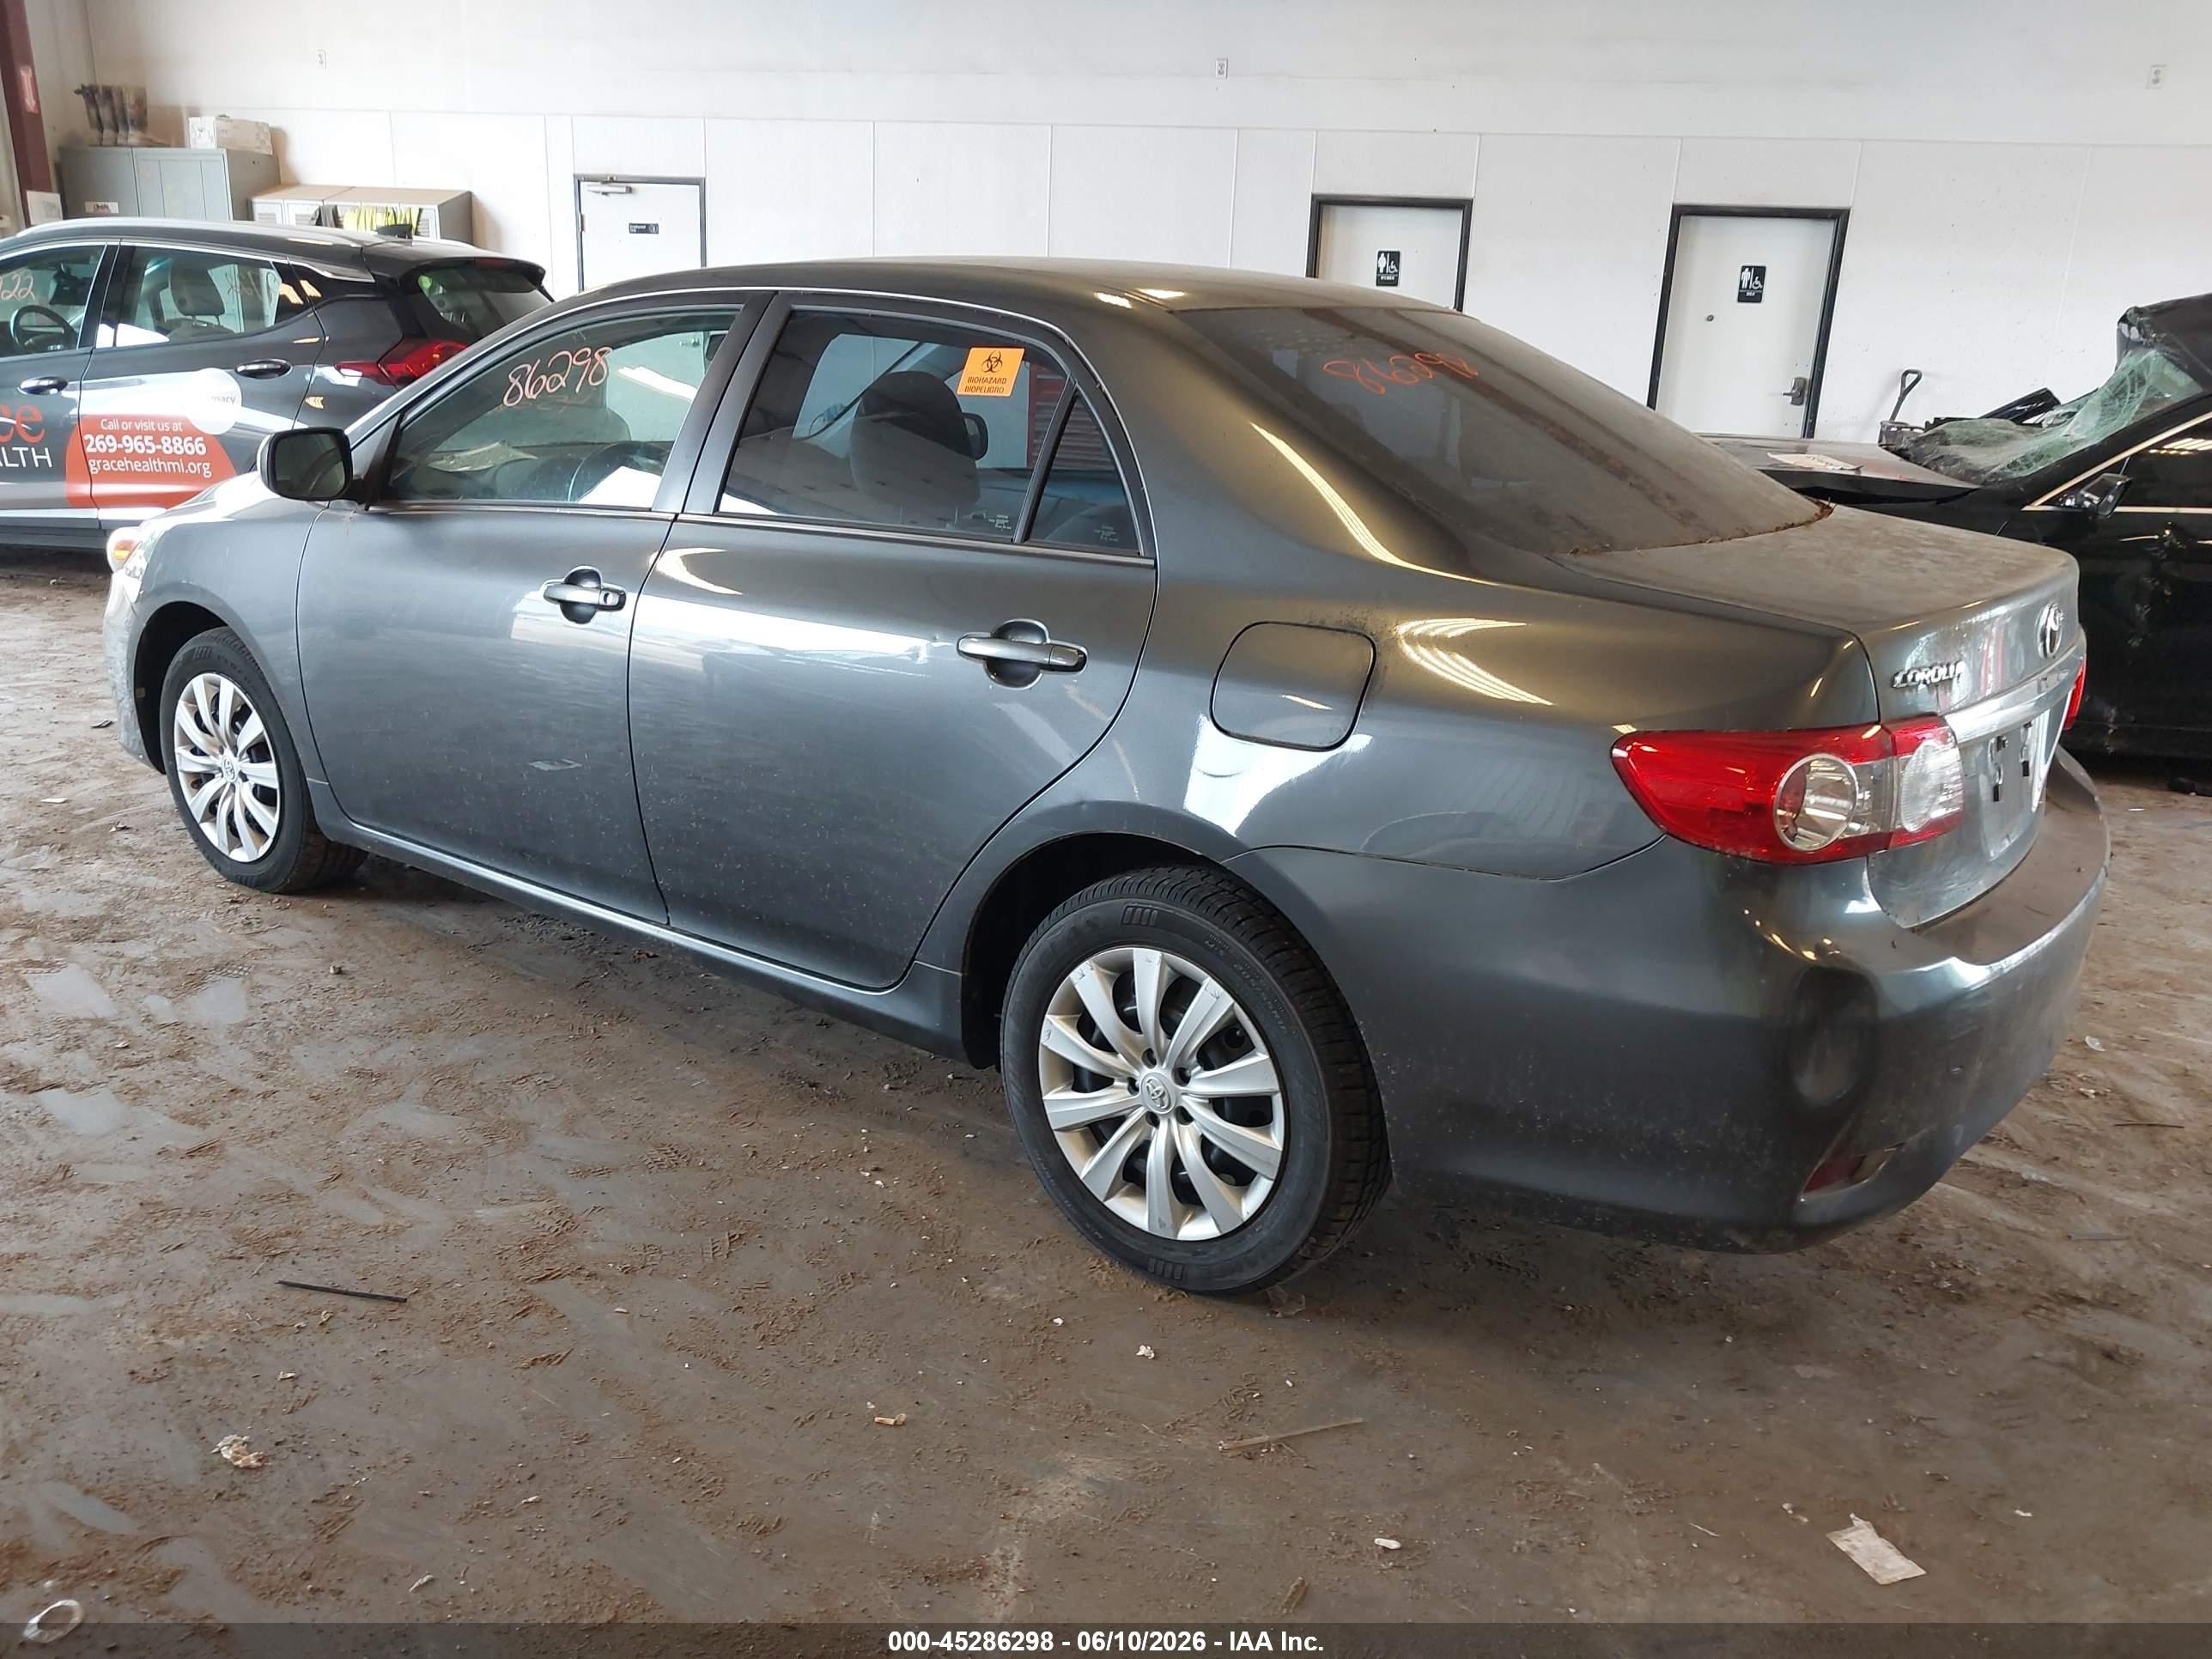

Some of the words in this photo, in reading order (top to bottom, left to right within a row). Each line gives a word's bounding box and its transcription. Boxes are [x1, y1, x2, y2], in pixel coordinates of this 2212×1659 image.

[503, 347, 613, 406] 86298
[100, 418, 119, 430] Call
[121, 422, 133, 430] or
[134, 420, 155, 431] visit
[157, 422, 170, 432] us
[173, 421, 183, 432] at
[85, 434, 207, 455] 269-965-8866
[0, 447, 52, 468] LTH
[88, 457, 212, 477] gracehealthmi.org
